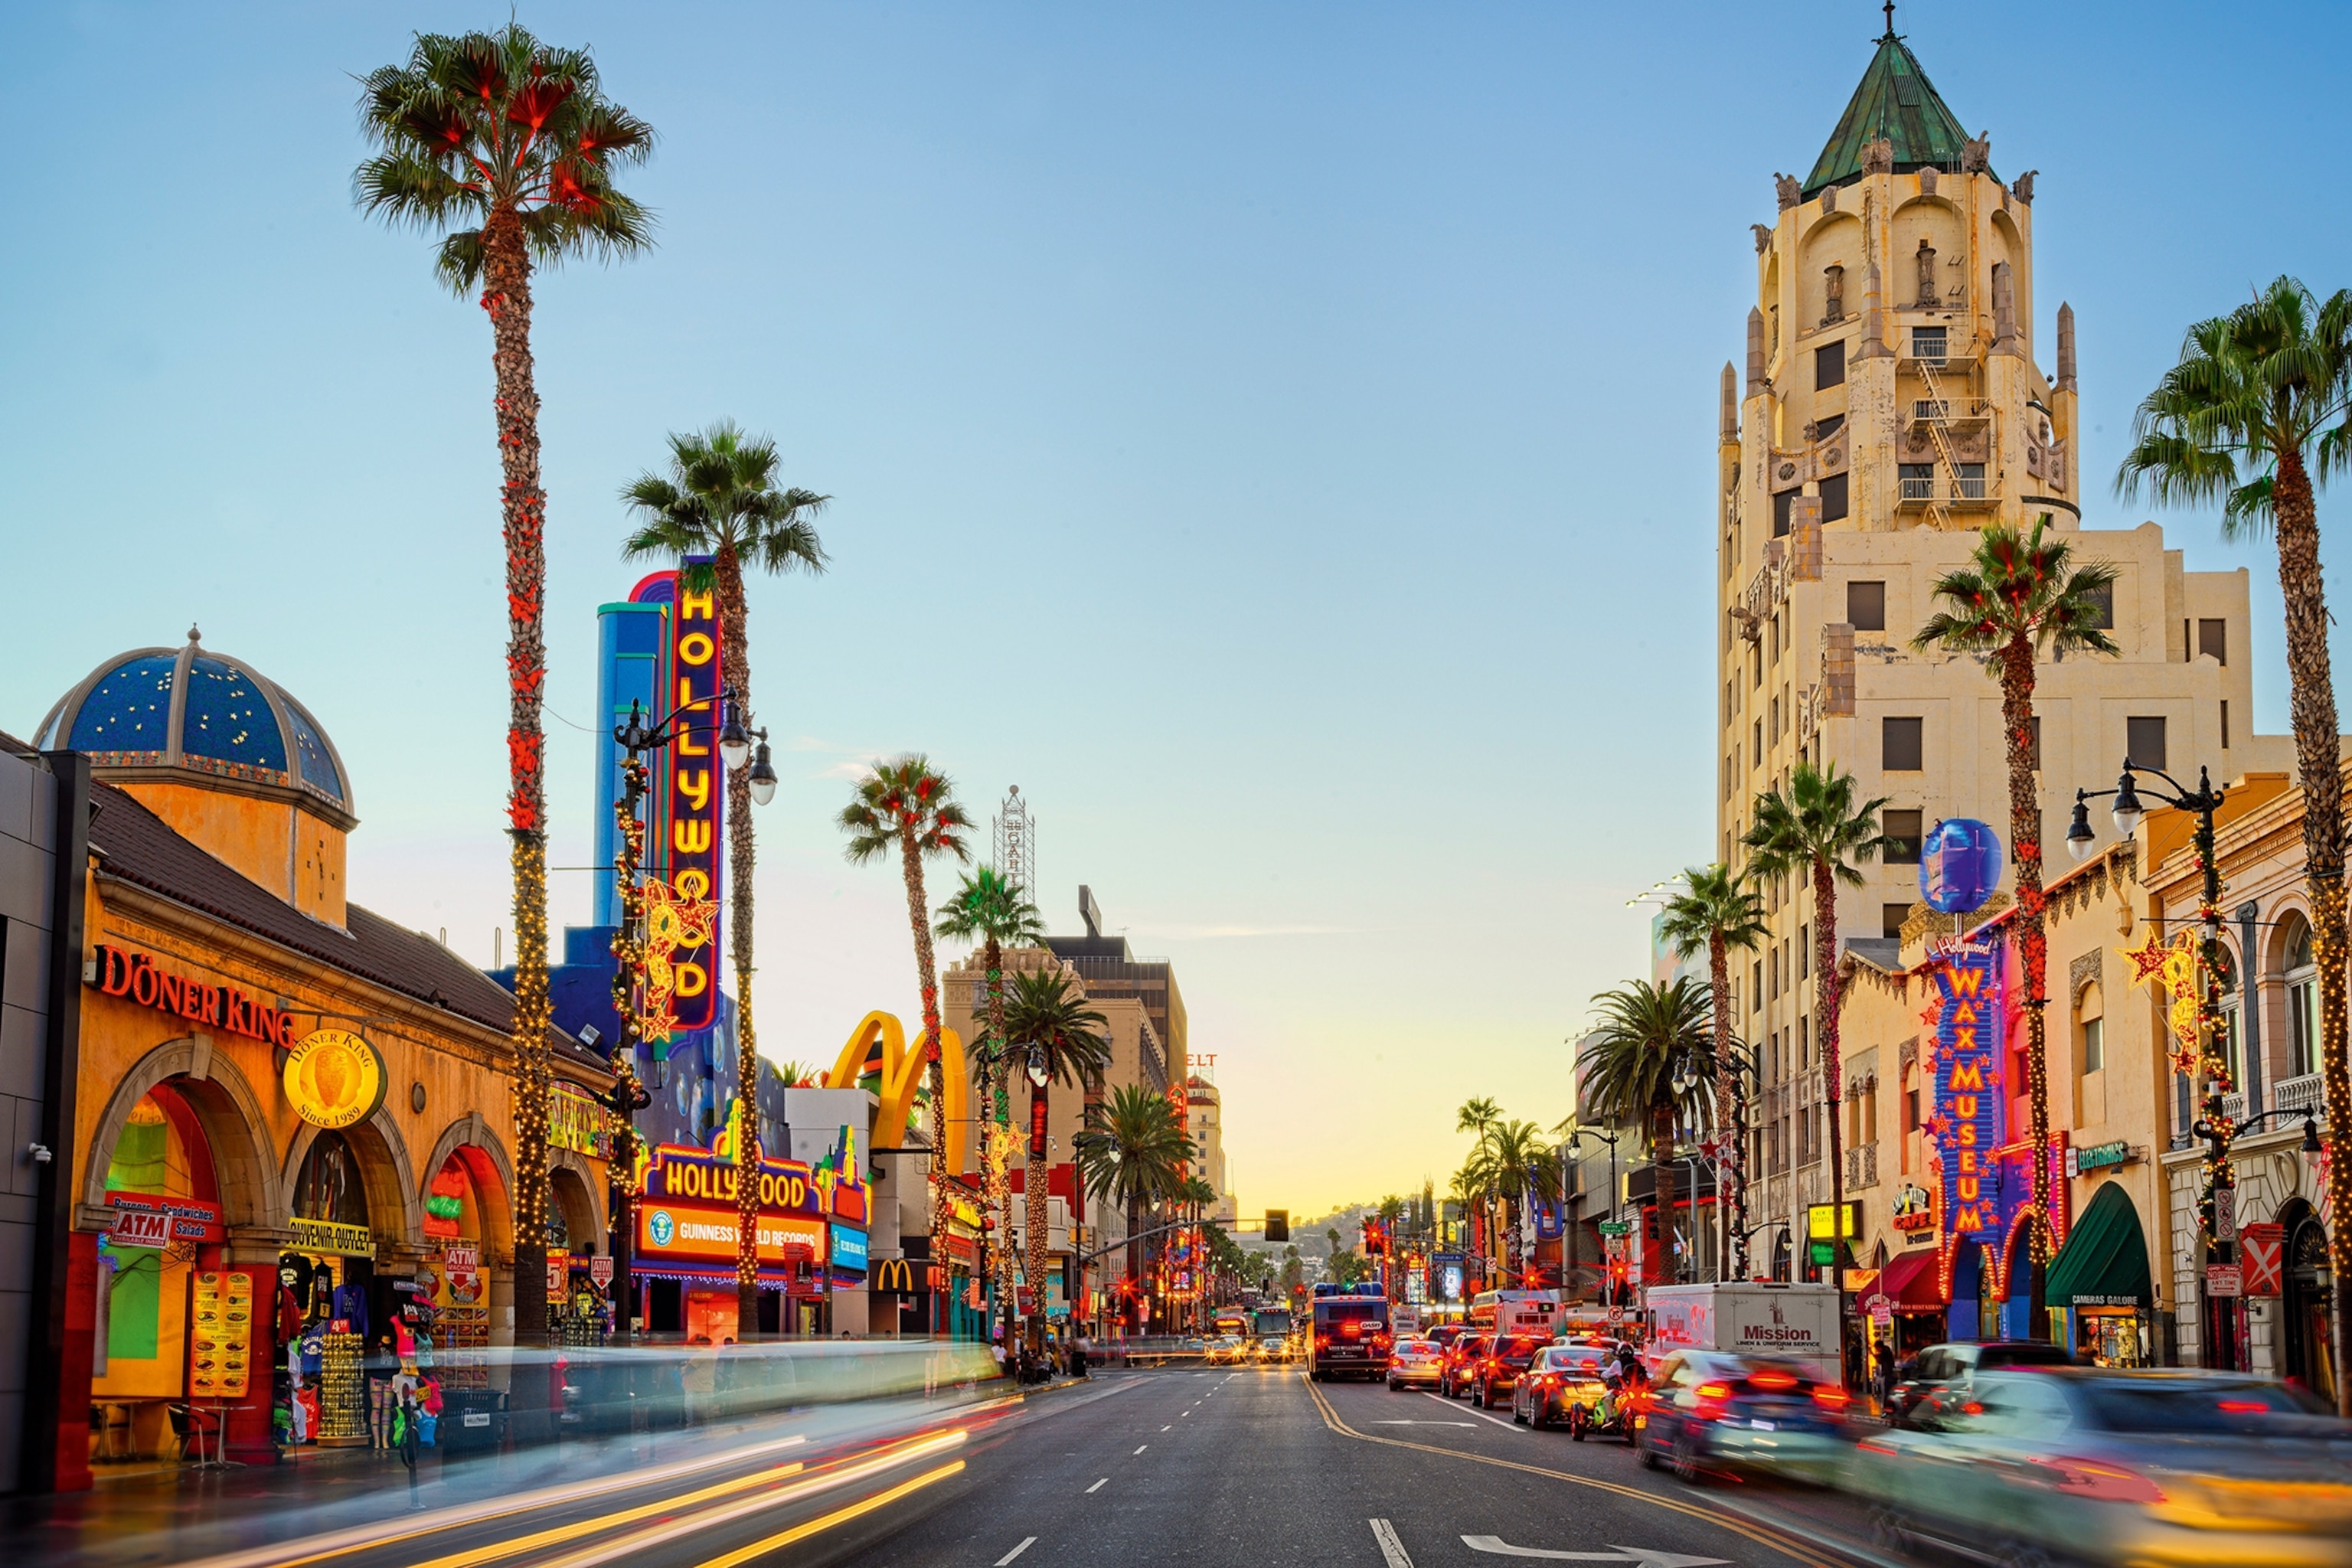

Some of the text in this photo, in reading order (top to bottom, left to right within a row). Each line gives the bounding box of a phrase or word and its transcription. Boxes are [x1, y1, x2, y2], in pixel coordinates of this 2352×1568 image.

[1938, 936, 1992, 962] Hollywood
[102, 944, 296, 1049] DÖNER KING
[289, 1034, 373, 1068] DÖNER KING
[1943, 966, 1985, 1232] WAX MUSEUM
[298, 1103, 361, 1126] Since 1989
[2079, 1142, 2124, 1171] ELECTRONICS
[666, 1161, 805, 1208] HOLLYOOD
[161, 1204, 214, 1221] Sandwiches
[1893, 1212, 1928, 1230] CAFE
[117, 1214, 165, 1237] ATM
[176, 1223, 205, 1237] Salads
[286, 1222, 369, 1252] OUVENIR OUTLET
[680, 1222, 733, 1243] GUINNESS
[772, 1230, 815, 1248] RECORDS
[447, 1250, 475, 1266] ATM
[593, 1260, 611, 1272] ATM
[2073, 1295, 2138, 1305] CAMERAS GALORE
[1744, 1325, 1811, 1341] Mission
